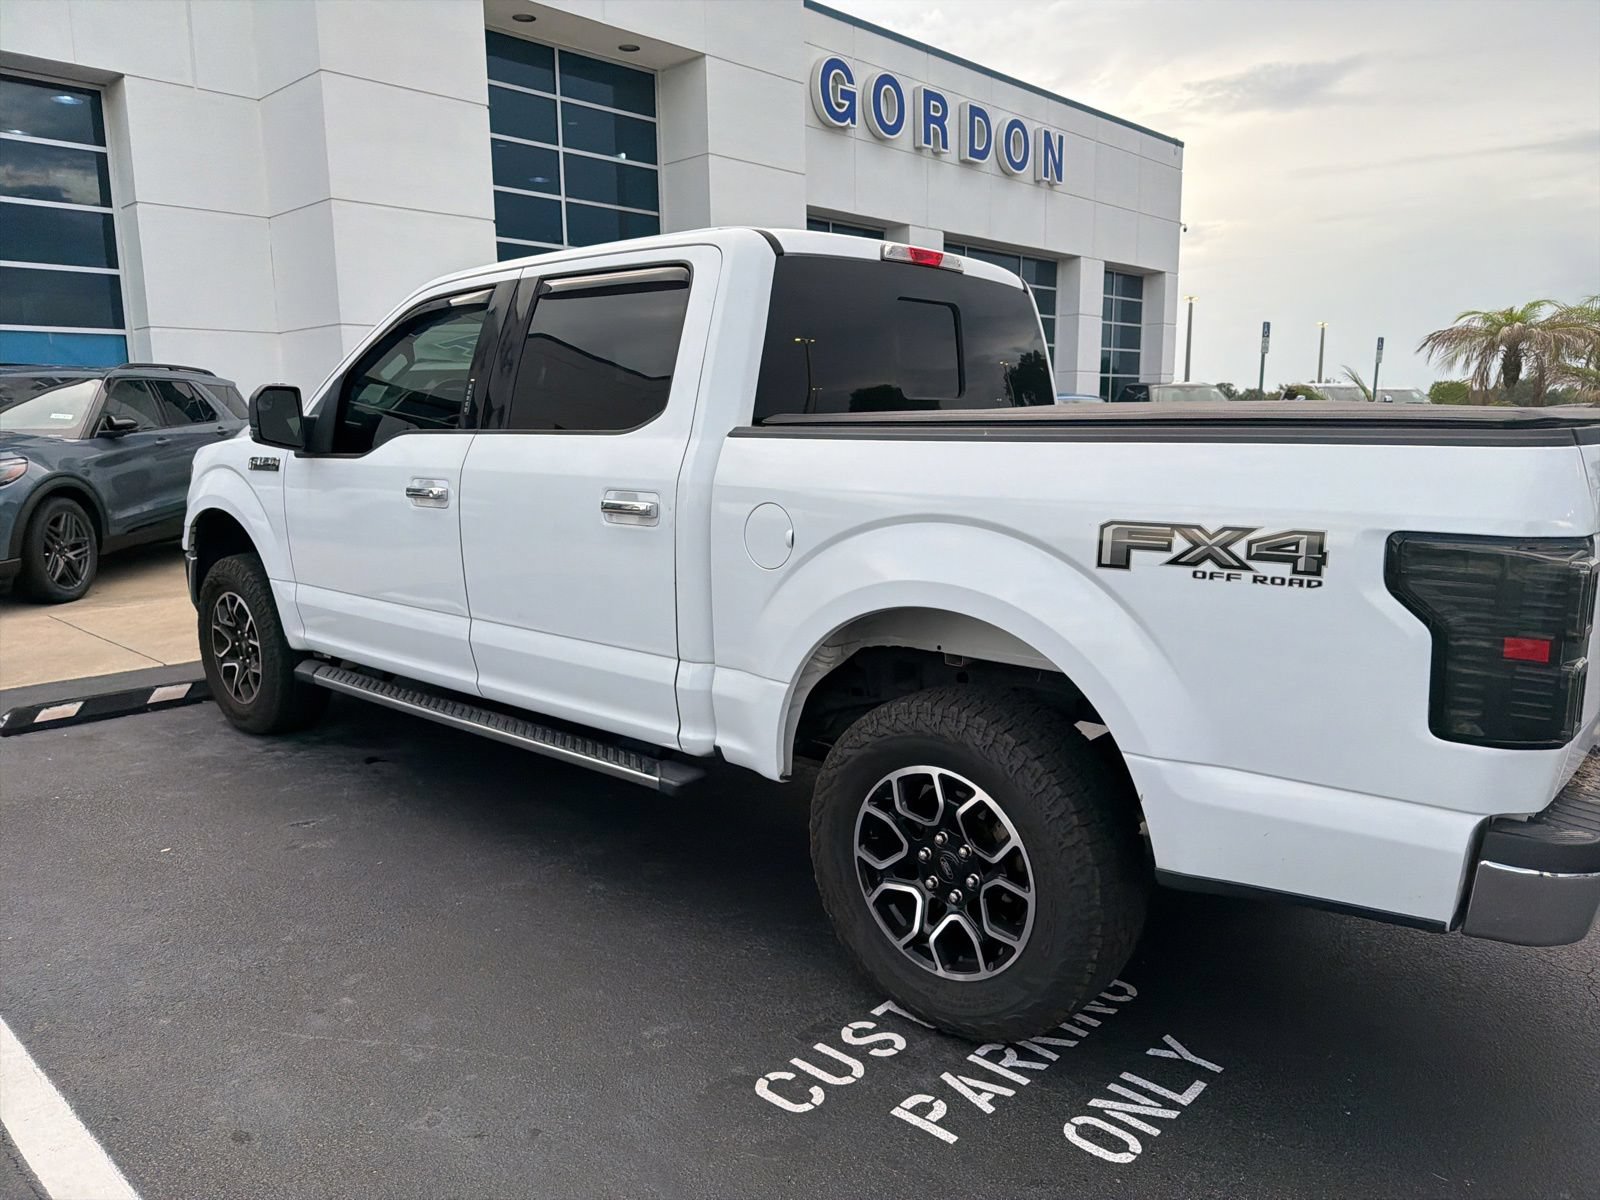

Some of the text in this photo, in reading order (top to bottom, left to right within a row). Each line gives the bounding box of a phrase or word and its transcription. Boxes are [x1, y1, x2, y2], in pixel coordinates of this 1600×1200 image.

[811, 55, 1065, 185] GORDON
[1097, 520, 1328, 577] FX4
[1192, 570, 1323, 588] OFF ROAD
[1063, 1035, 1224, 1163] ONLY
